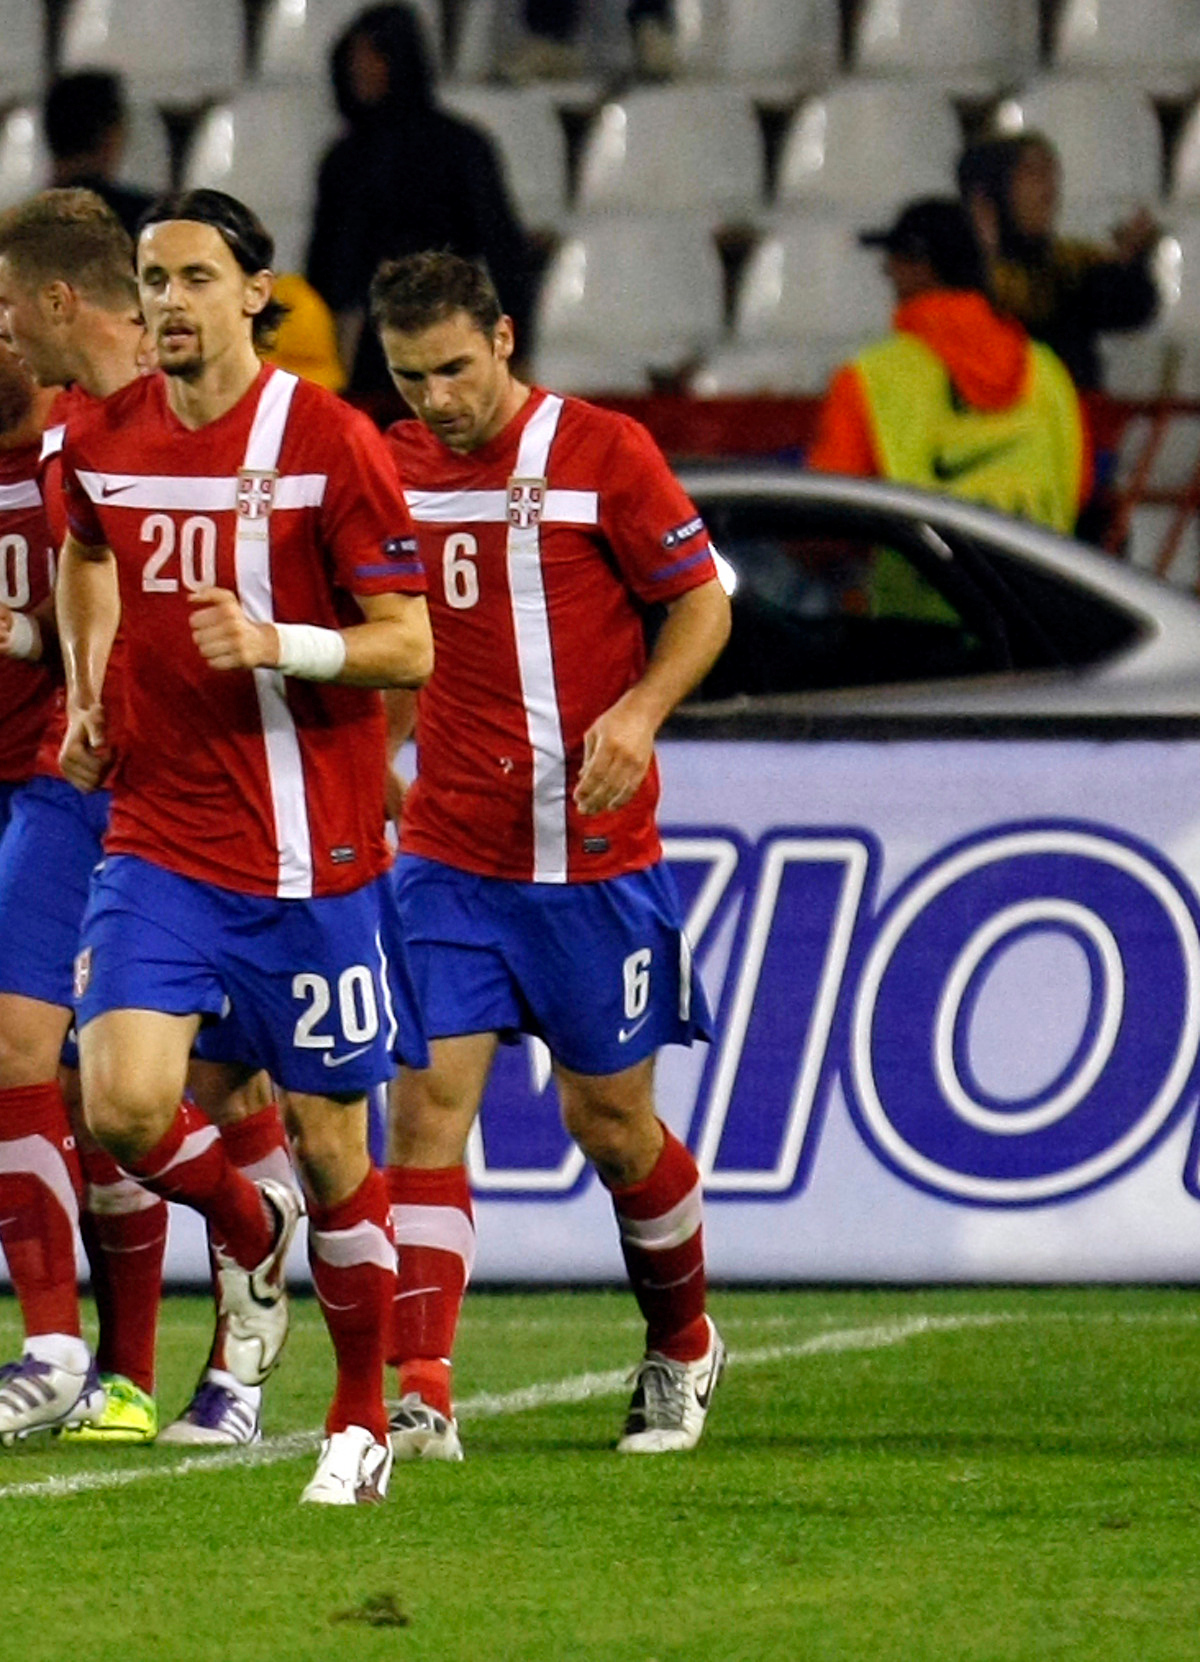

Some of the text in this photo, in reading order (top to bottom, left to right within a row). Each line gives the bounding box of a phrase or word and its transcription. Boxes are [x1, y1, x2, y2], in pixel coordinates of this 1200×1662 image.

[140, 513, 217, 594] 20
[443, 532, 480, 609] 6
[292, 965, 379, 1048] 20
[623, 948, 652, 1019] 6
